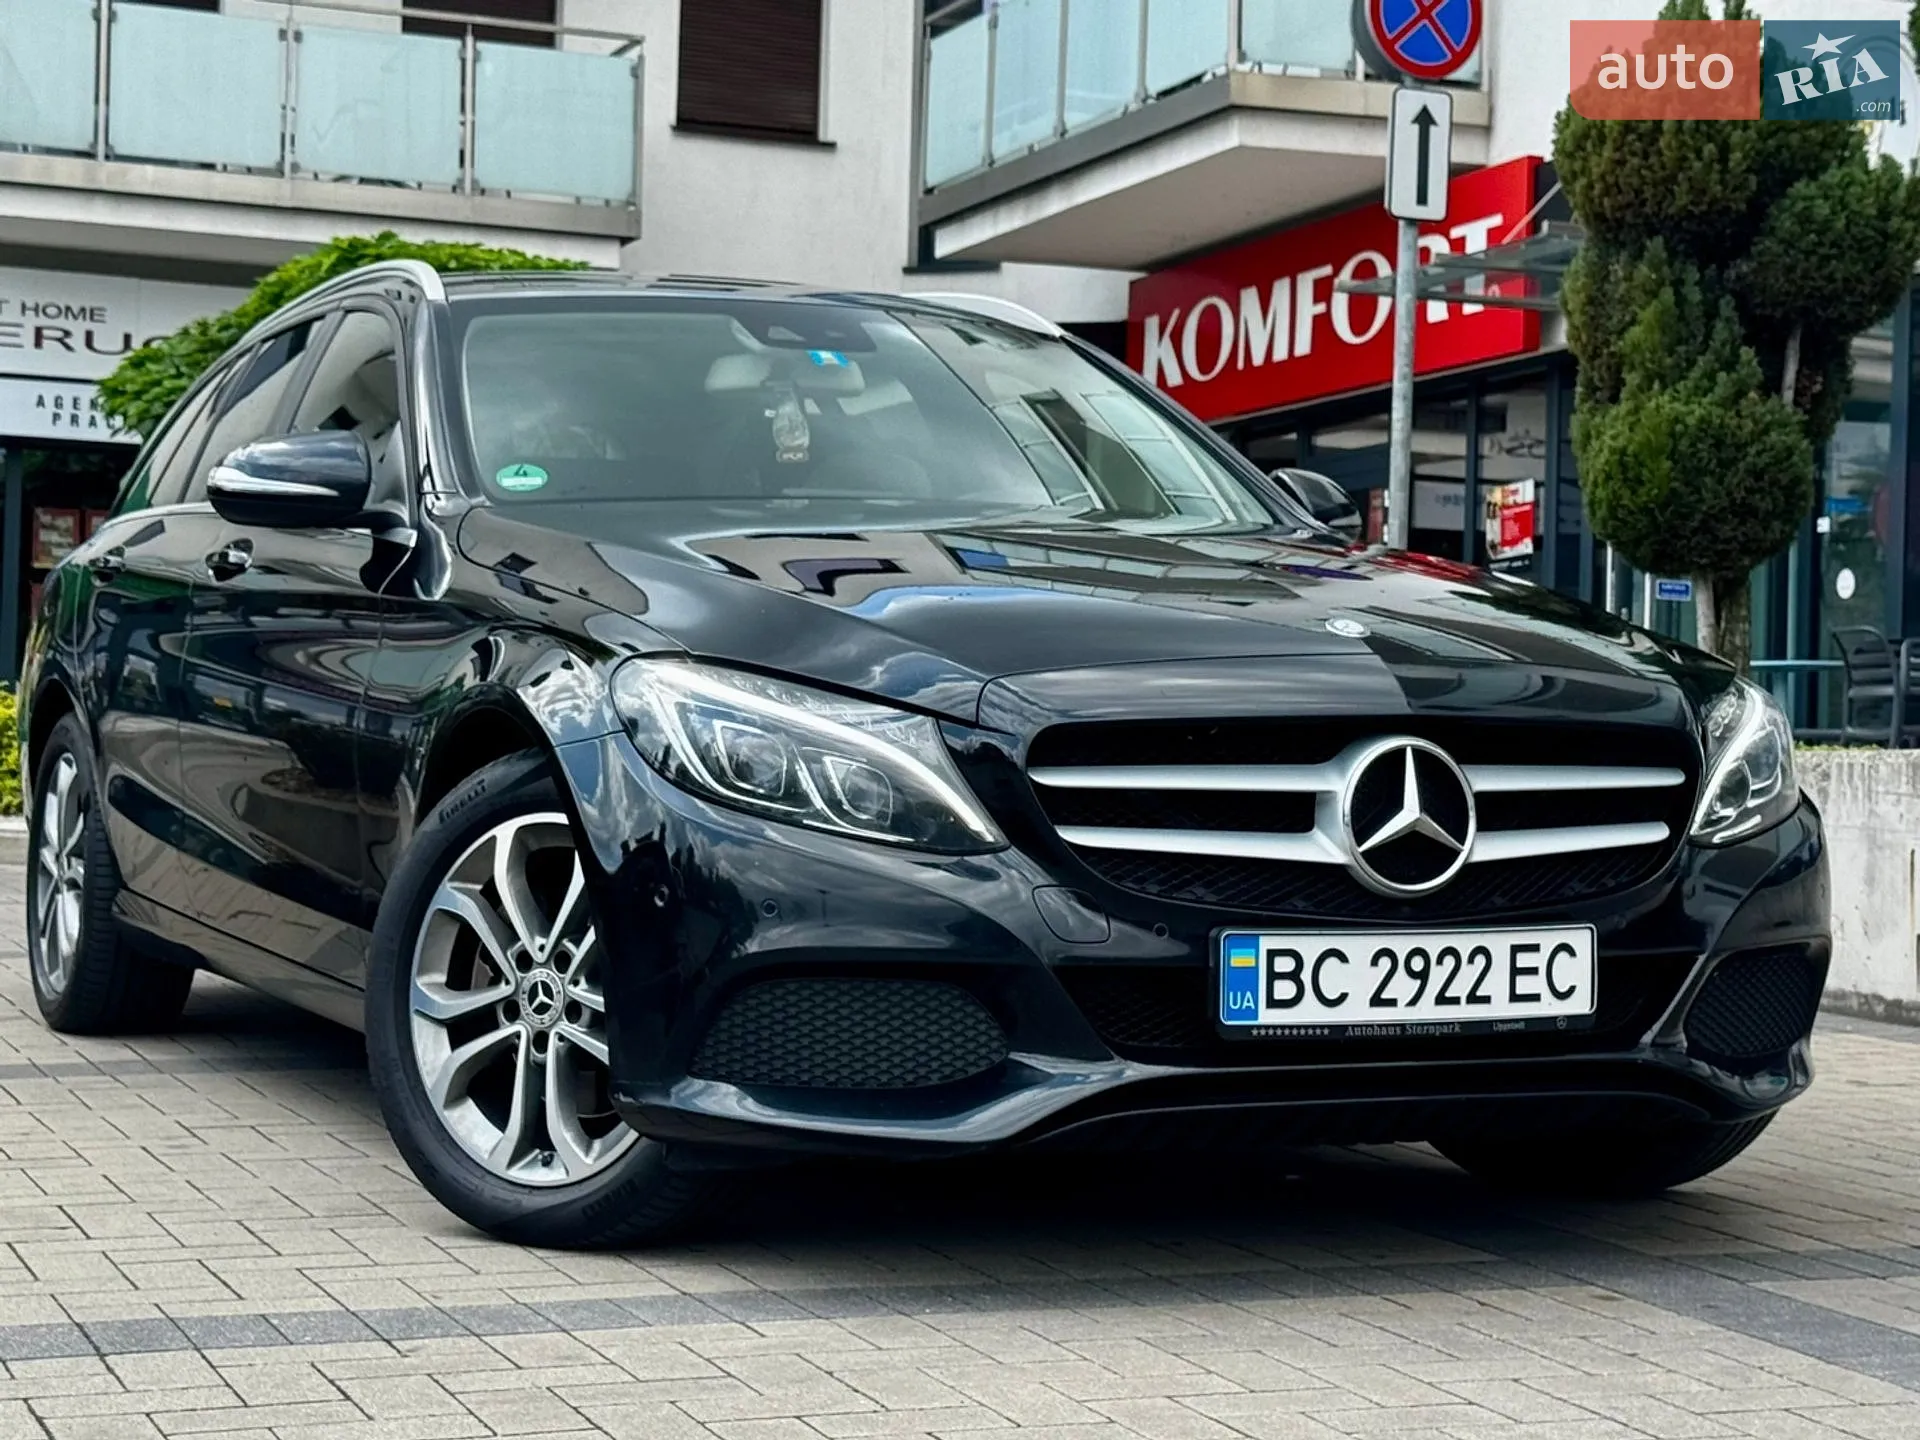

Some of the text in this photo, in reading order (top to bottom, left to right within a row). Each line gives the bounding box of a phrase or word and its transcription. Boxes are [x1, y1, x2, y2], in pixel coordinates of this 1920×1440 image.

[21, 300, 107, 324] HOME
[1141, 213, 1503, 388] KOMFORT
[1265, 942, 1577, 1009] BC 2922 EC
[1229, 992, 1255, 1010] UA
[1345, 1024, 1401, 1037] Autohaus
